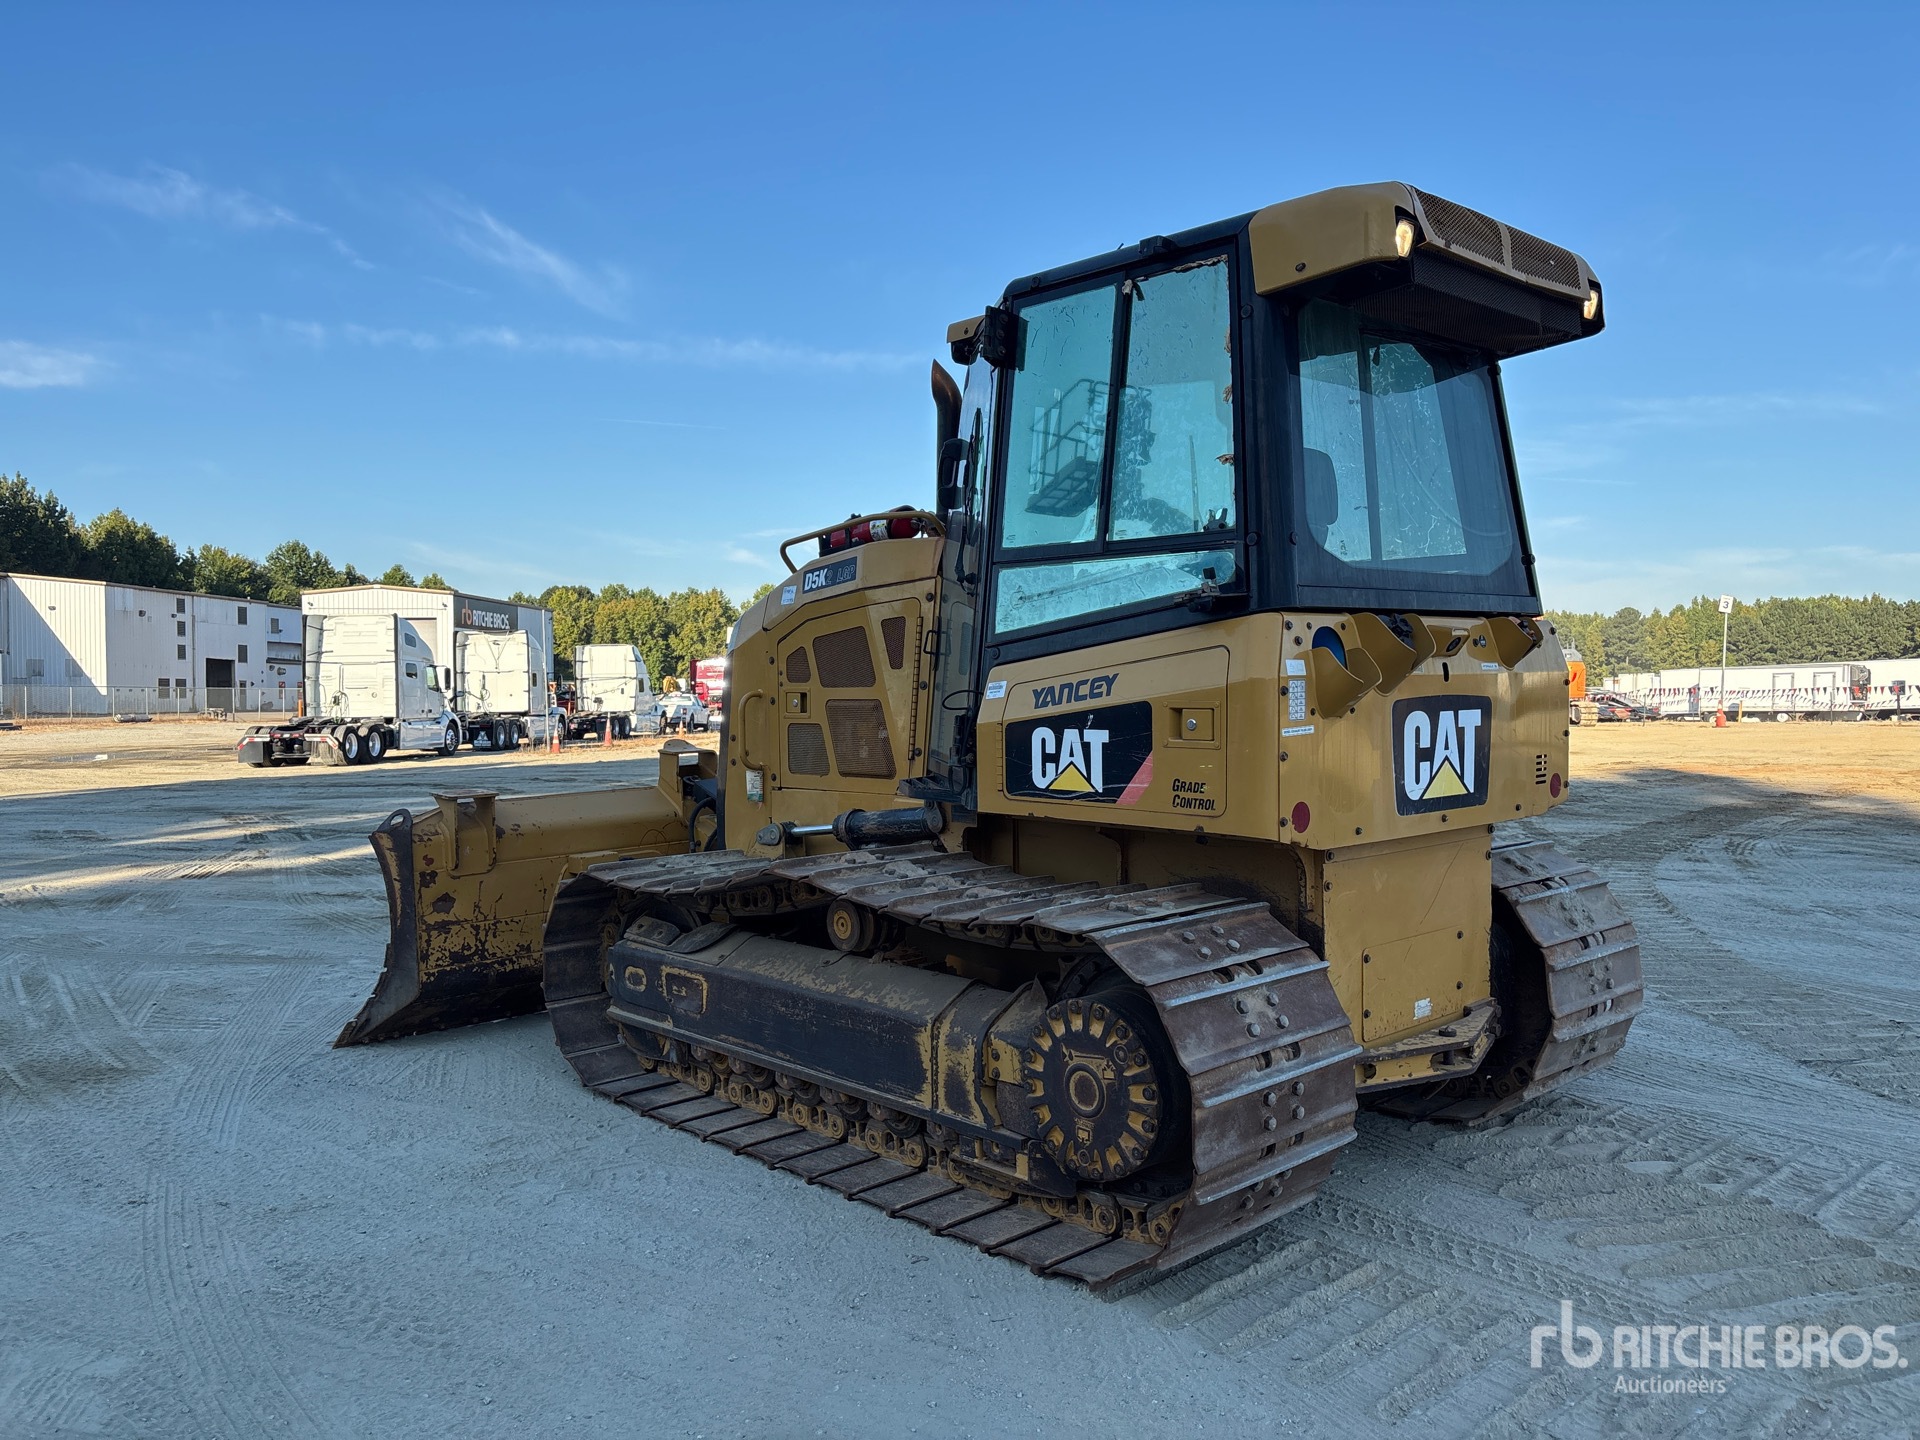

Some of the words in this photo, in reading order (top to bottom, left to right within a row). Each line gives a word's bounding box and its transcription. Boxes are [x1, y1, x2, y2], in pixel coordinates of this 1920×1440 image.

[837, 564, 856, 582] LGP
[1722, 601, 1729, 609] 3
[472, 610, 493, 628] RITCHIE
[493, 613, 511, 630] BROS.
[1032, 673, 1119, 709] YANCEY
[1031, 726, 1110, 793] CAT
[1403, 709, 1481, 801] CAT
